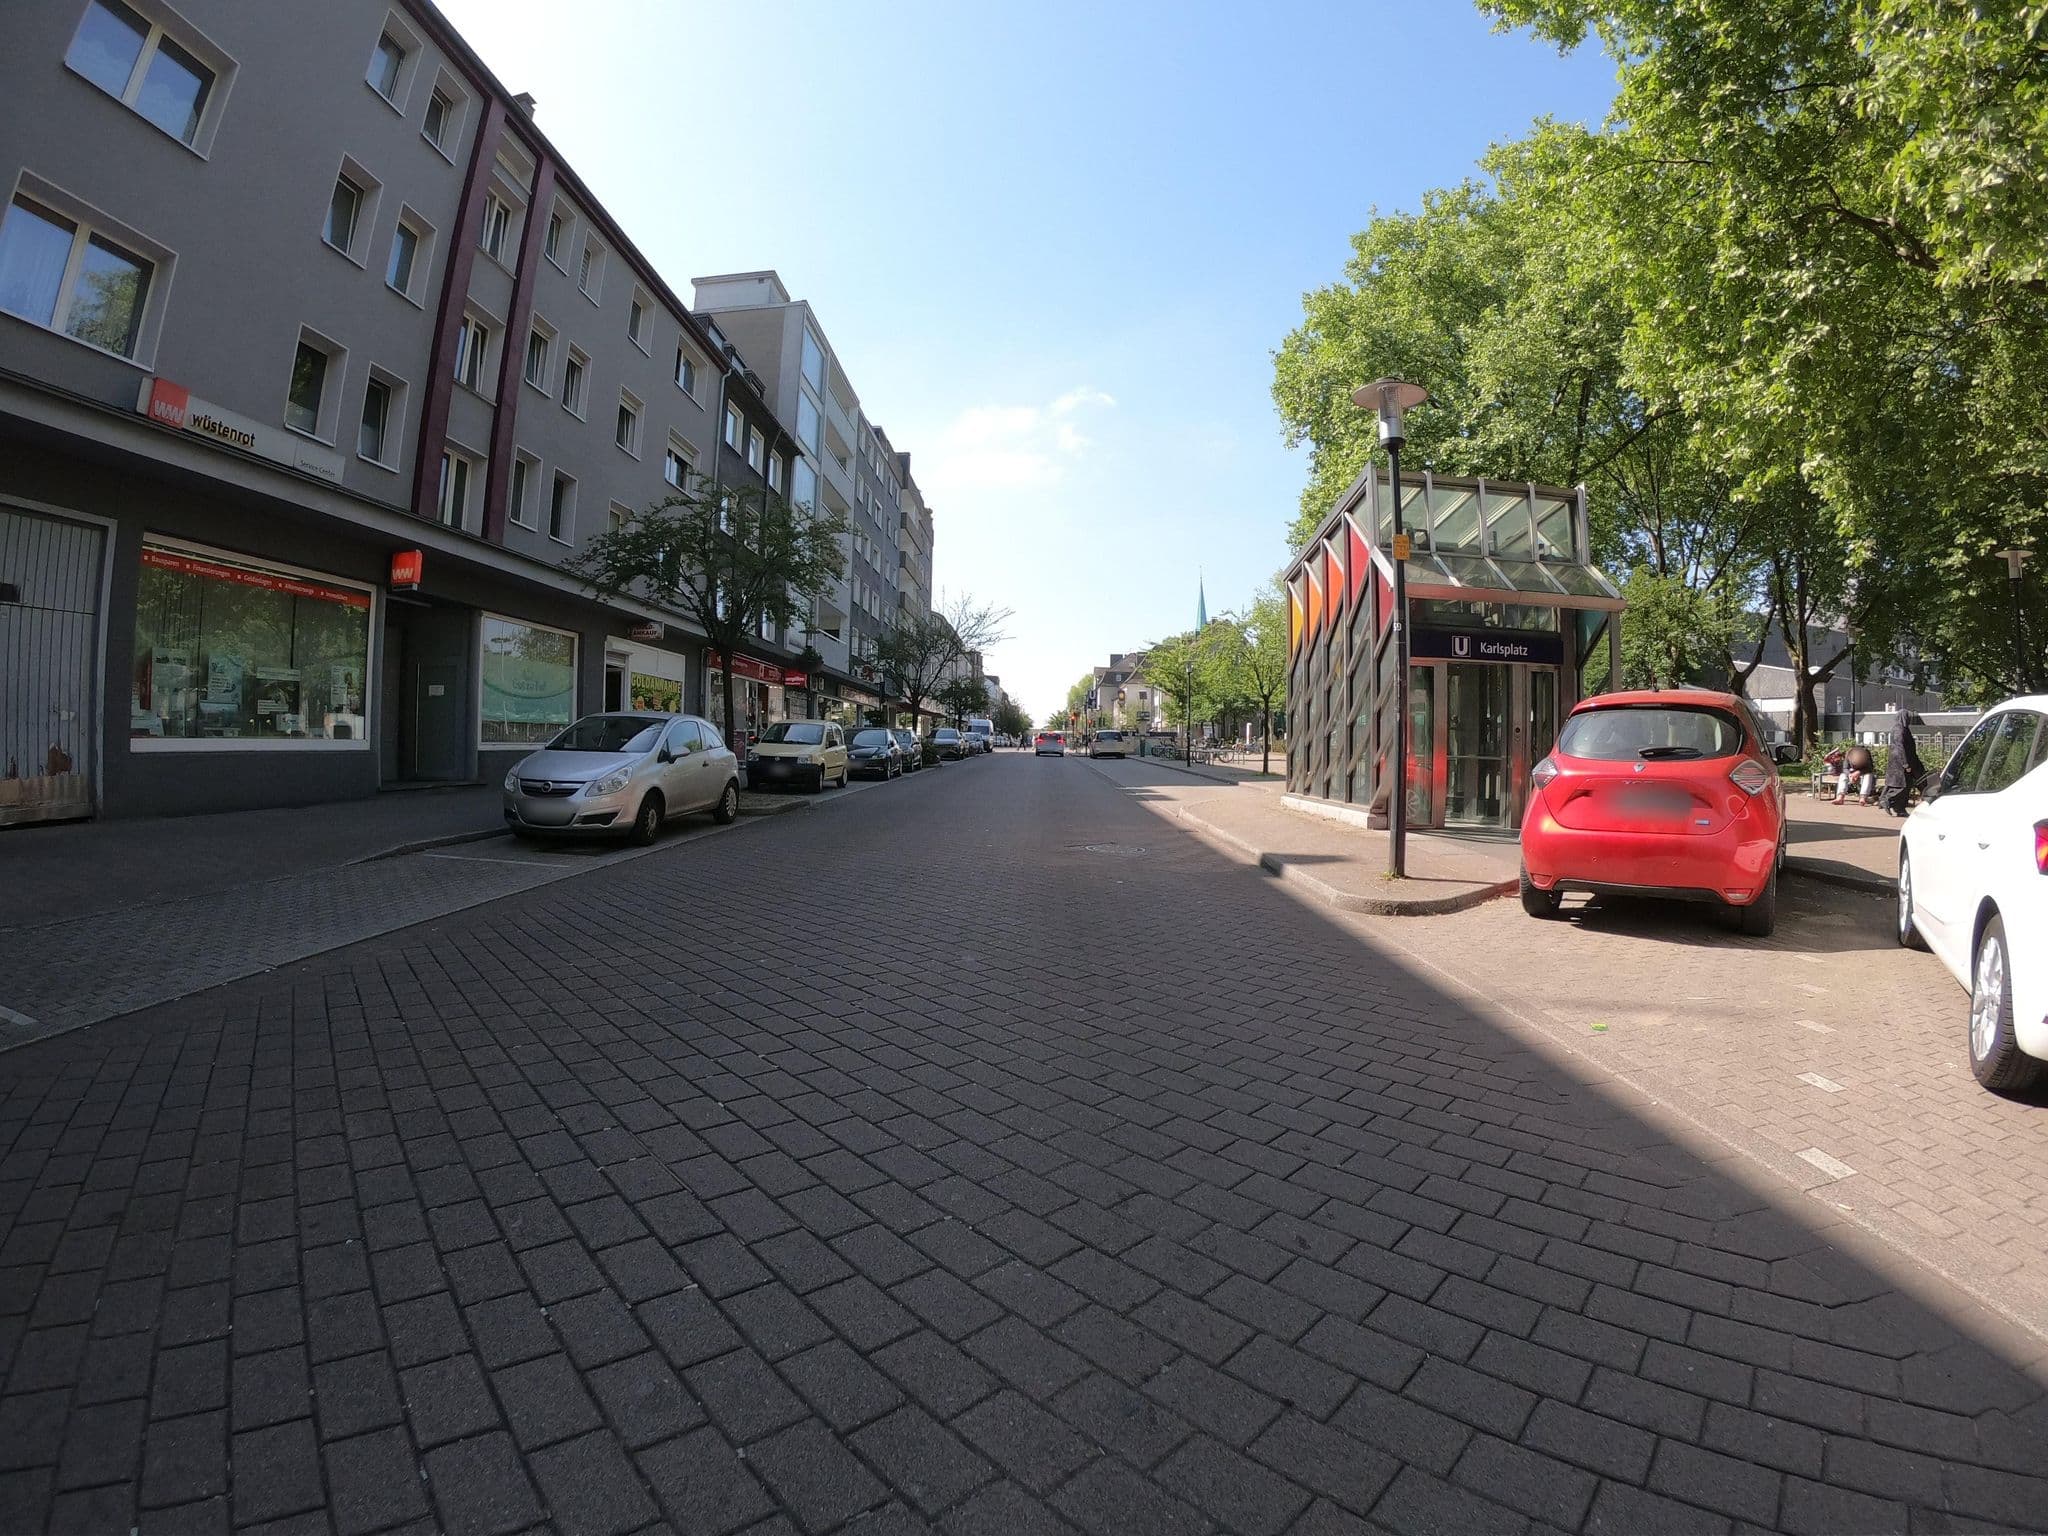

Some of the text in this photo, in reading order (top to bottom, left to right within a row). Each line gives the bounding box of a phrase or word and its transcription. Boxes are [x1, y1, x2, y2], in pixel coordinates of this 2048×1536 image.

[192, 413, 255, 447] wüstenrot
[151, 555, 180, 567] Bausparen
[192, 563, 231, 578] Finanzierungen
[1480, 641, 1528, 657] Karlsplatz
